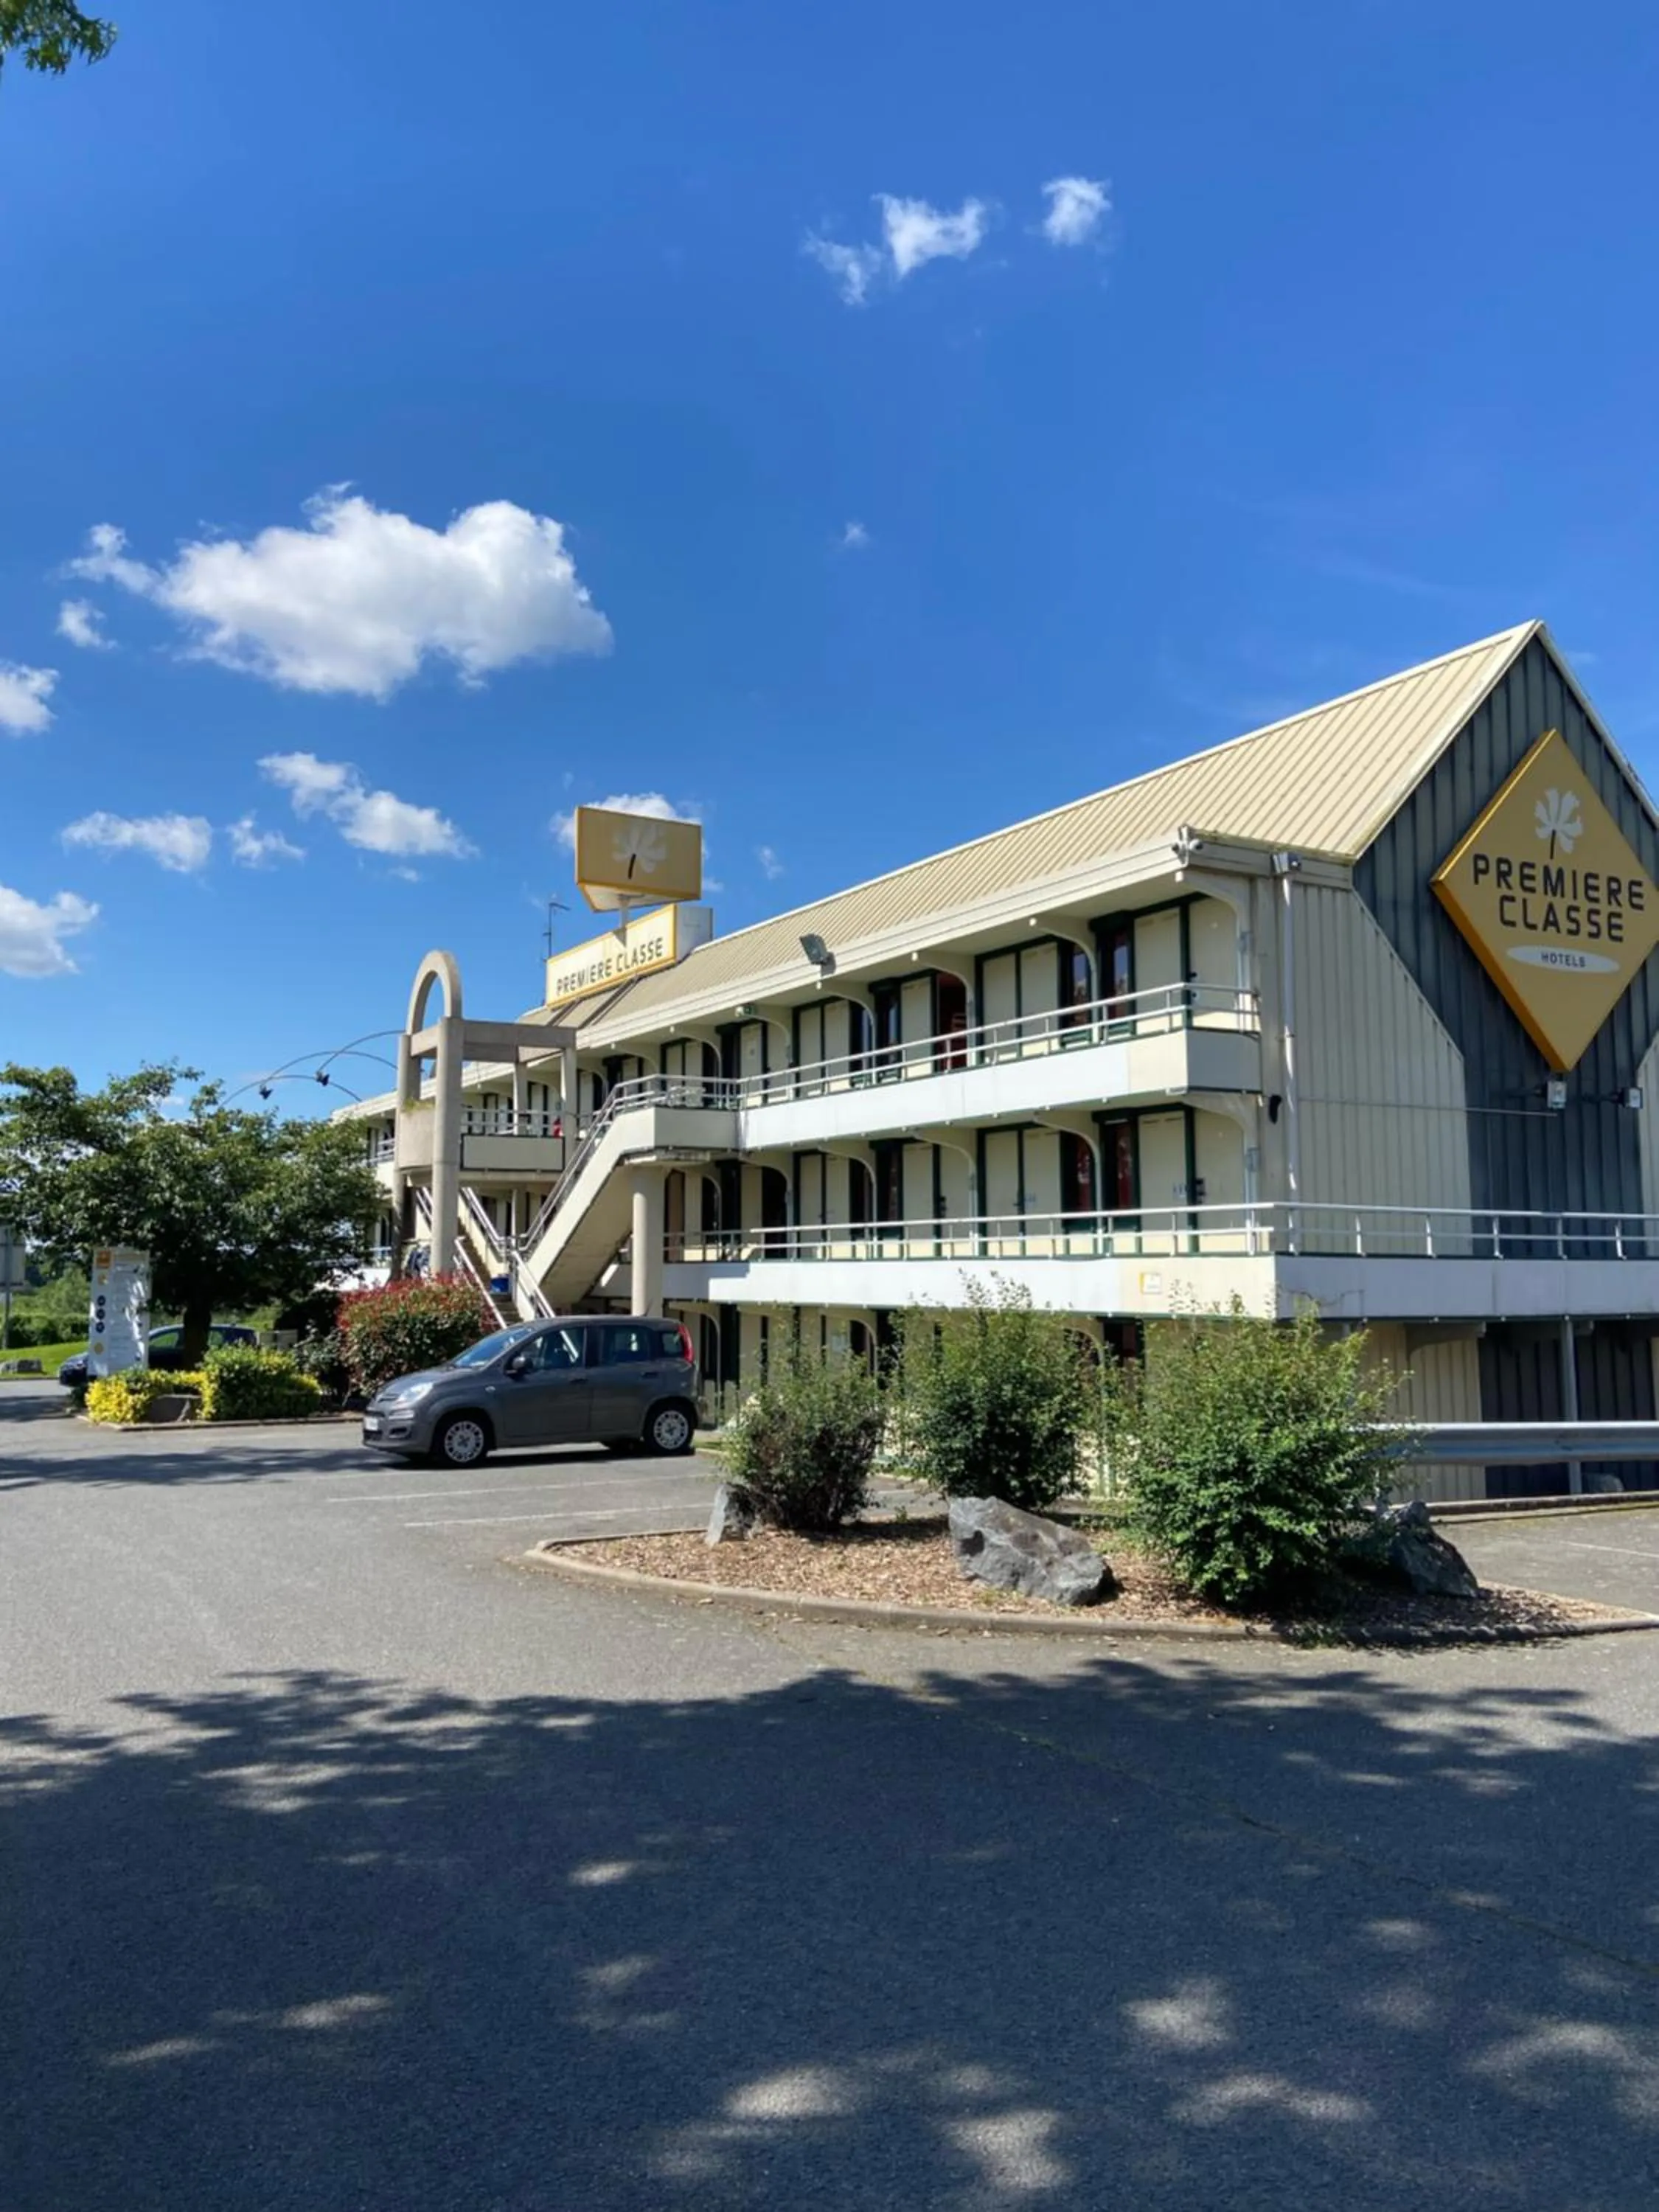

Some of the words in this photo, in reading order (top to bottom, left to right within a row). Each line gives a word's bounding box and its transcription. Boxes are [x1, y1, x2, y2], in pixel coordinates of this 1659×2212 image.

[1472, 853, 1645, 911] PREMIERE
[1498, 894, 1624, 942] CLASSE
[556, 958, 613, 997] PREMIERE
[616, 937, 664, 973] CLASSE
[1540, 951, 1586, 968] HOTELS
